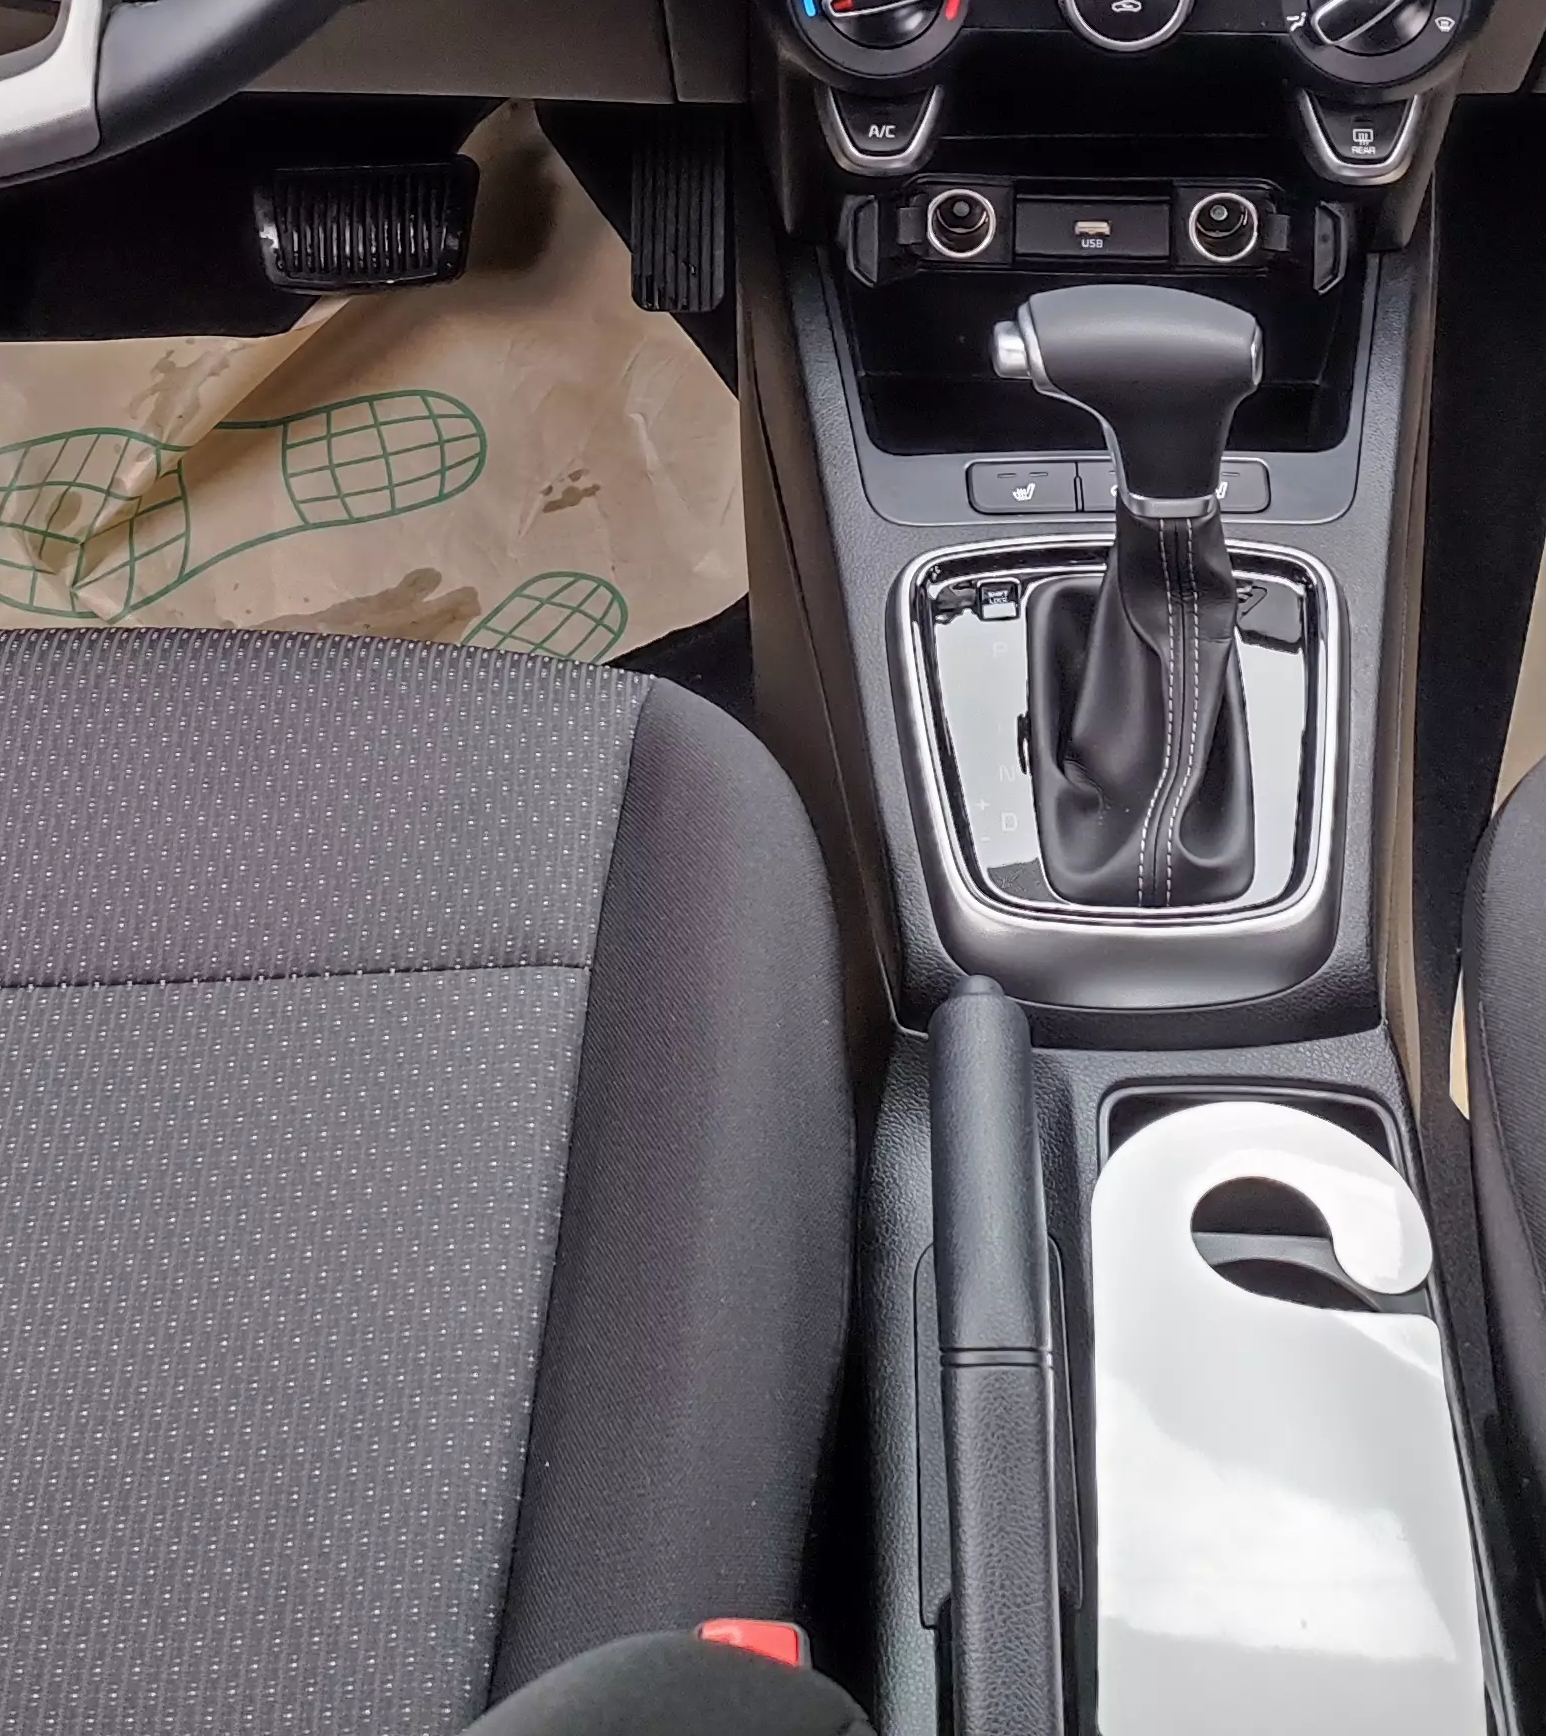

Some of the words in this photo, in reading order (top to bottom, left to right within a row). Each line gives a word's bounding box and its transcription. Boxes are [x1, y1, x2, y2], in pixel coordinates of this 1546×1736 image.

[868, 124, 896, 139] A/C
[1351, 145, 1376, 155] REAR
[1081, 238, 1104, 249] USB
[1000, 811, 1019, 832] D
